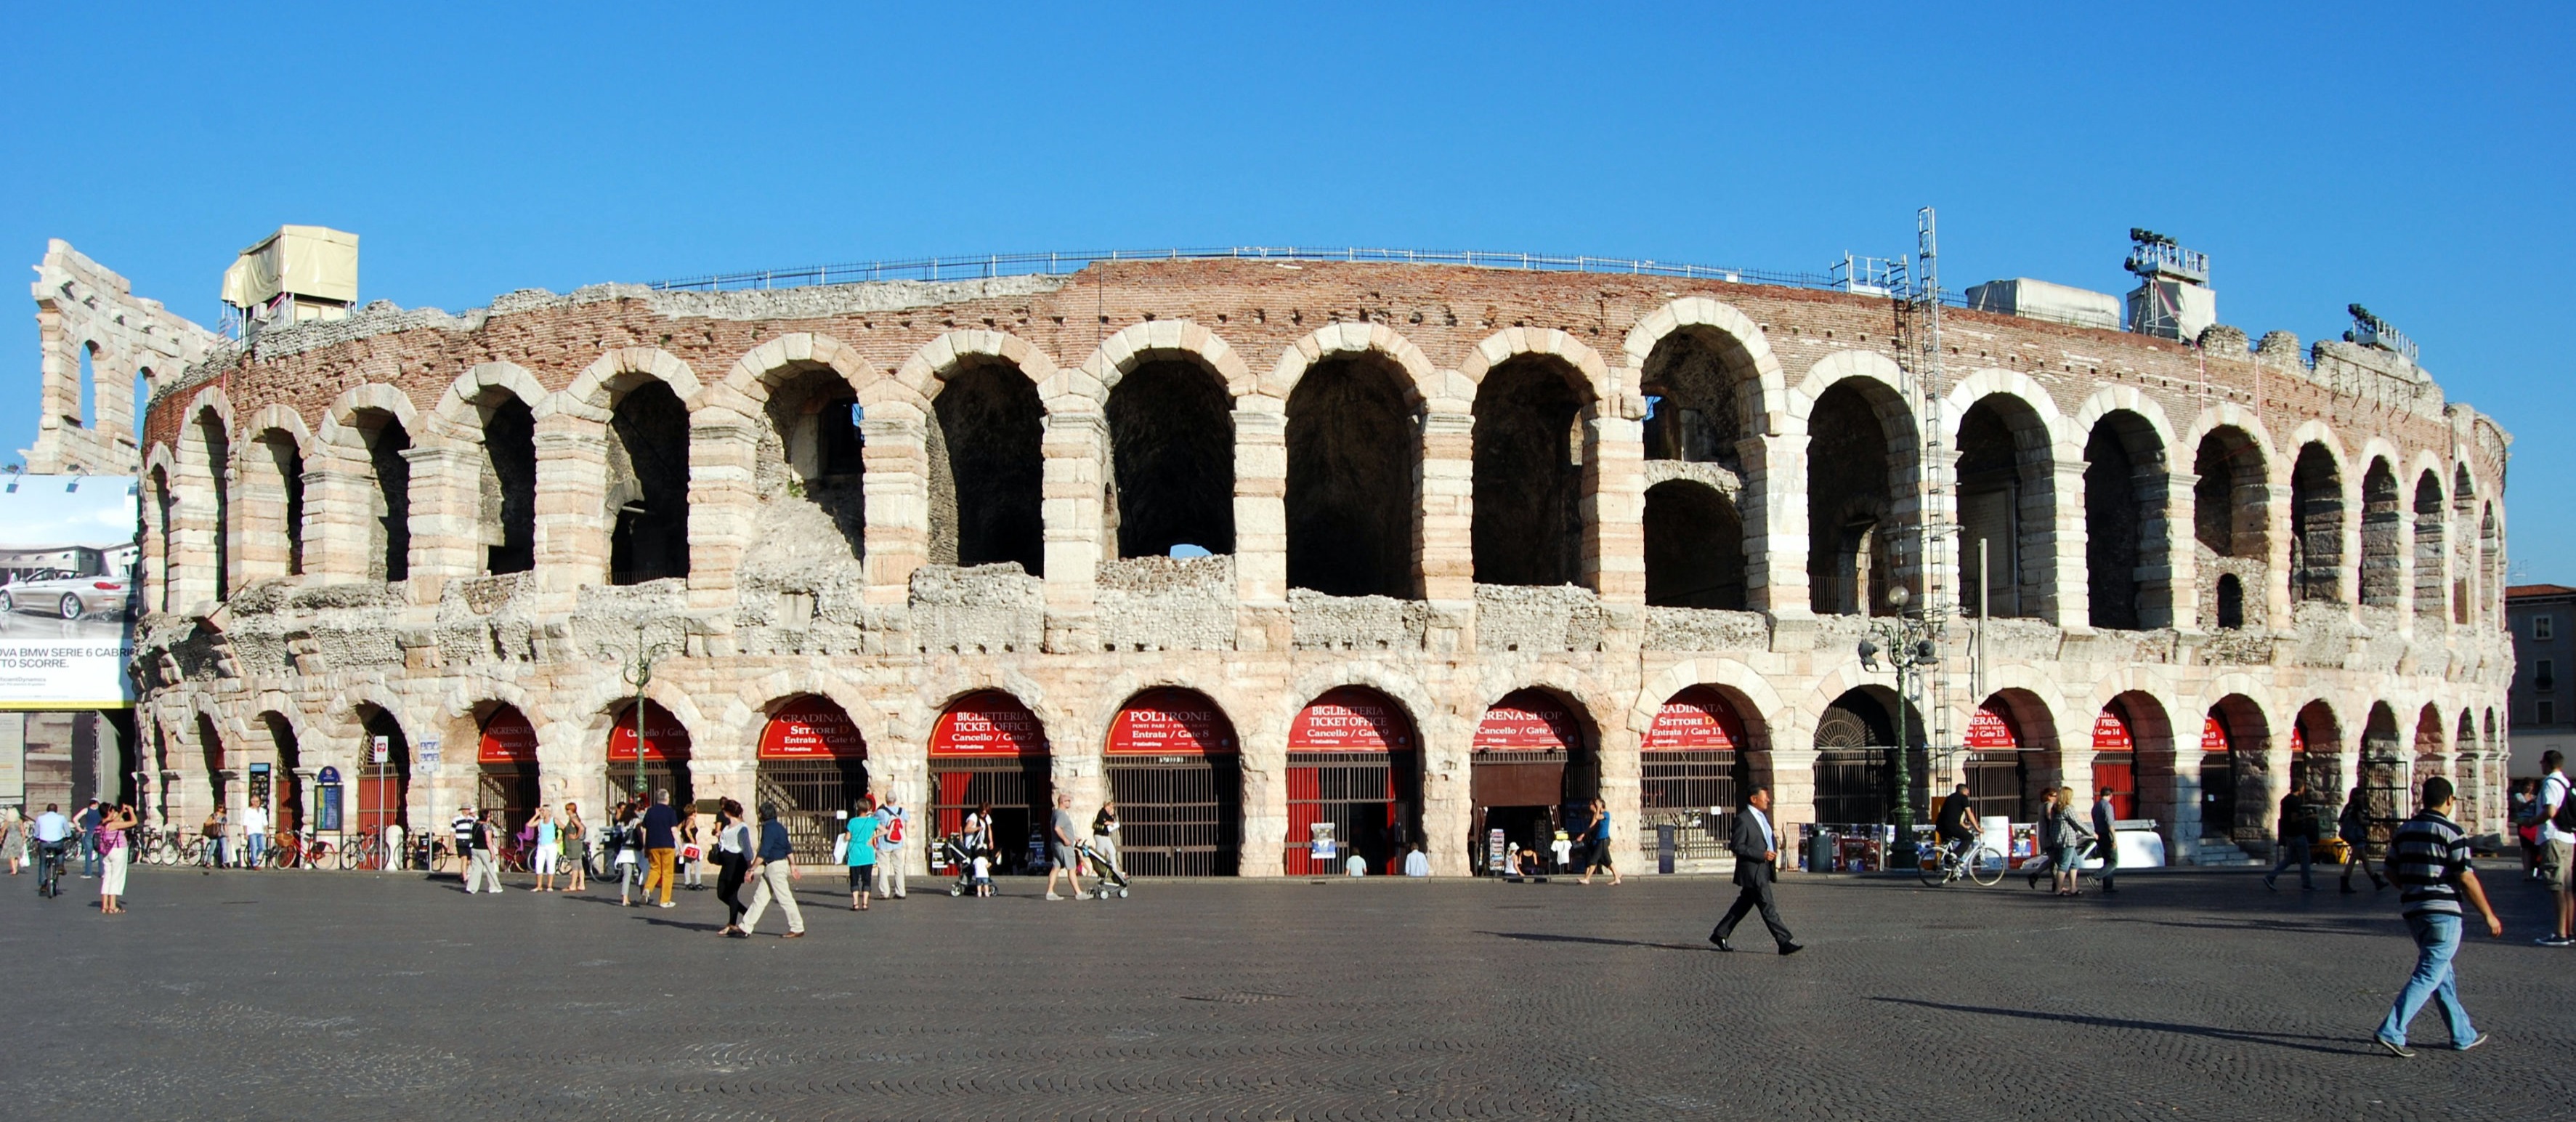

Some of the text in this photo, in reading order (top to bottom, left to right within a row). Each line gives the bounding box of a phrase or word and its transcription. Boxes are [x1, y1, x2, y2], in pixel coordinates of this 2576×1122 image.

[20, 647, 49, 657] BMW
[51, 647, 84, 657] SERIE
[86, 647, 93, 657] 6
[19, 658, 70, 668] SCORRE.
[1311, 706, 1384, 716] BIGLIETTERIA
[1526, 711, 1563, 720] SHOP
[957, 711, 1028, 722] BIGLIETTERIA
[1130, 711, 1212, 722] POLTRONE
[1658, 717, 1715, 726] SETTORE D
[954, 722, 1032, 732] TICKET OFFICE
[1309, 717, 1387, 727] TICKET OFFICE
[627, 728, 660, 738] Caello
[667, 727, 686, 736] Gate
